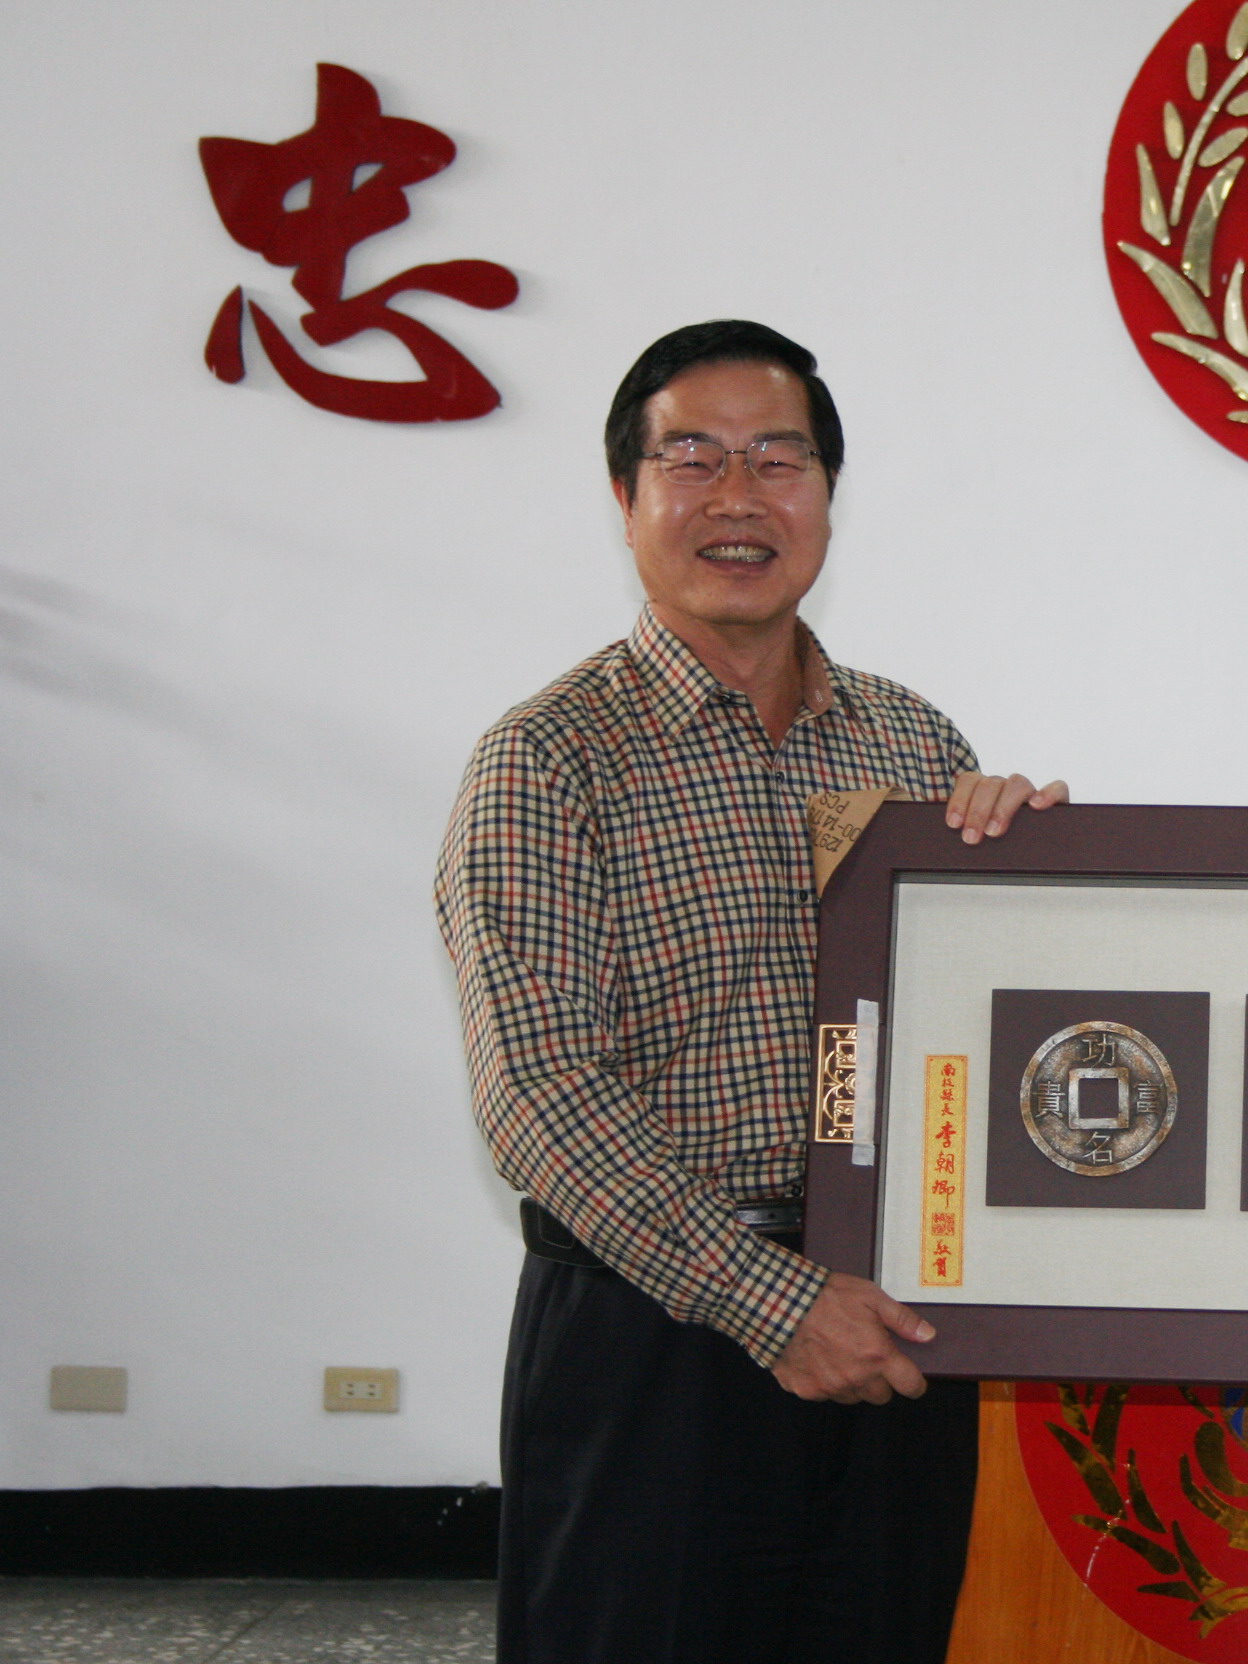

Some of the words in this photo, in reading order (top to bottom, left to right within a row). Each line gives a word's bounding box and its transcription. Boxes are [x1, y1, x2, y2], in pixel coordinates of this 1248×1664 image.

[198, 62, 520, 424] 忠
[820, 791, 850, 815] PCS
[1082, 1034, 1116, 1068] 功
[1032, 1081, 1066, 1118] 貴
[1136, 1080, 1164, 1115] 富
[1082, 1131, 1113, 1165] 名
